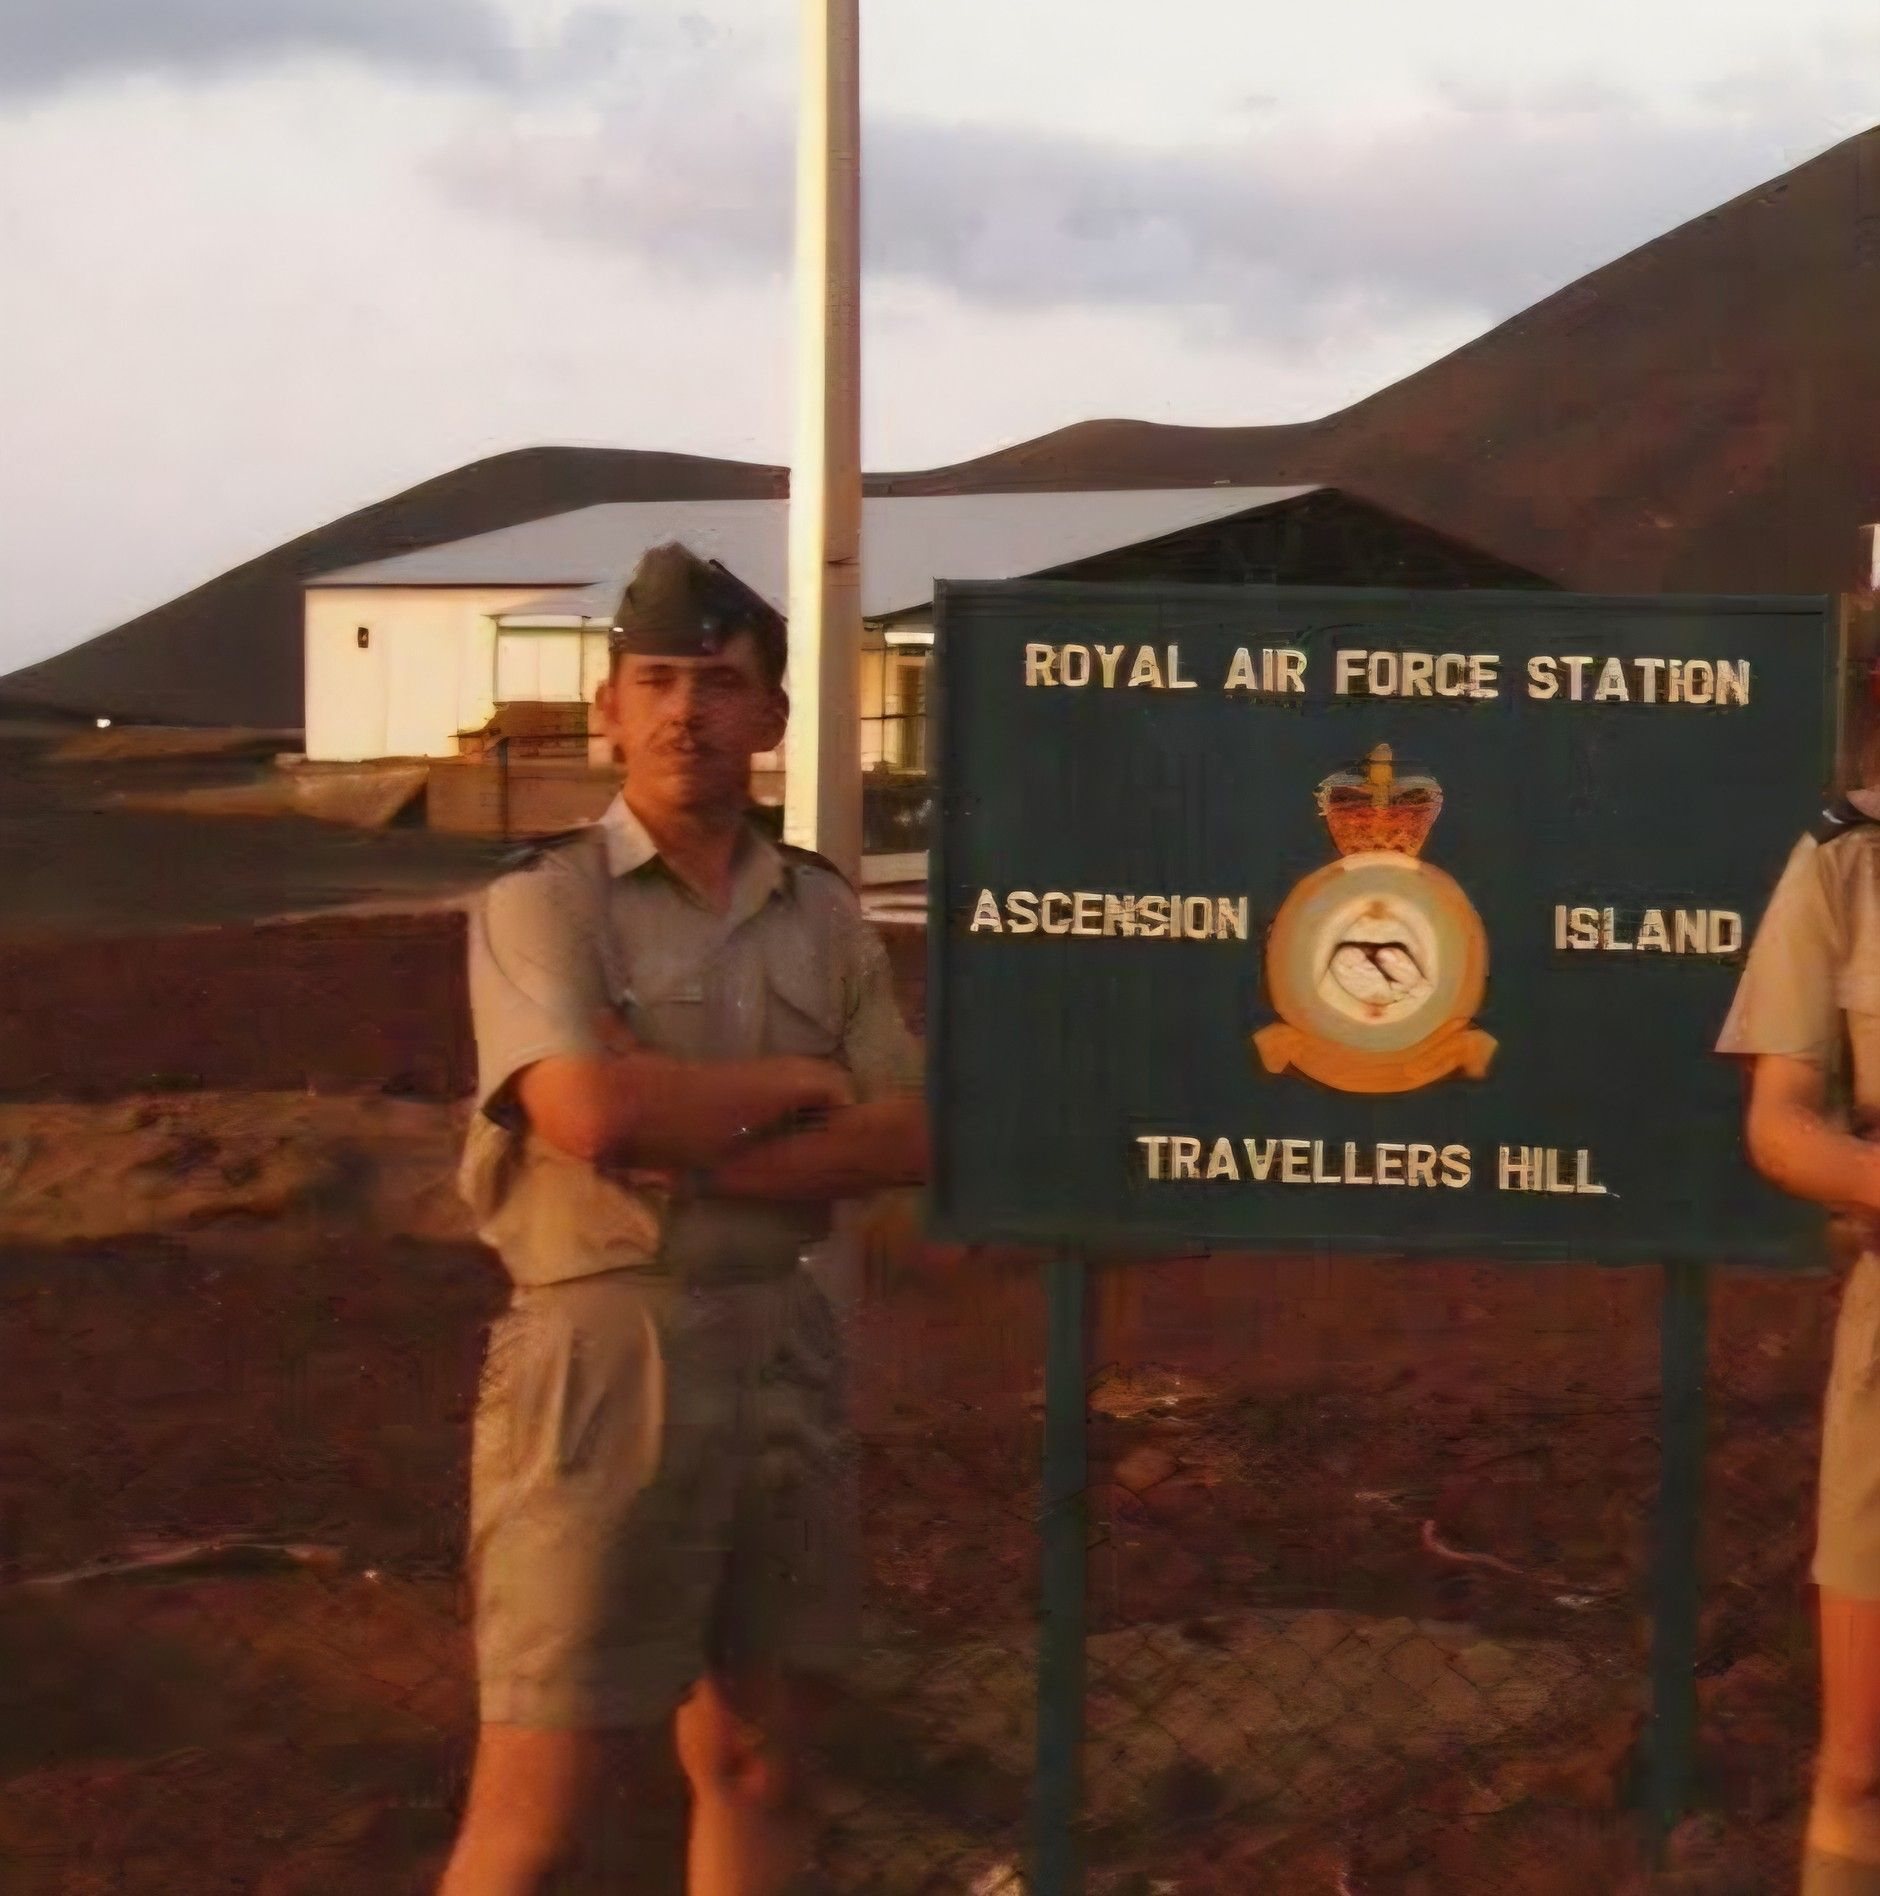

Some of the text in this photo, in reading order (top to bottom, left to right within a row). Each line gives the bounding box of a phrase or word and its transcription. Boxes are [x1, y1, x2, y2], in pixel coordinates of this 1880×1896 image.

[1025, 643, 1751, 706] ROYAL AIR FORCE STATION
[969, 888, 1742, 955] ASCENSION ISLAND
[1136, 1135, 1608, 1195] TRAVELLERS HILL
